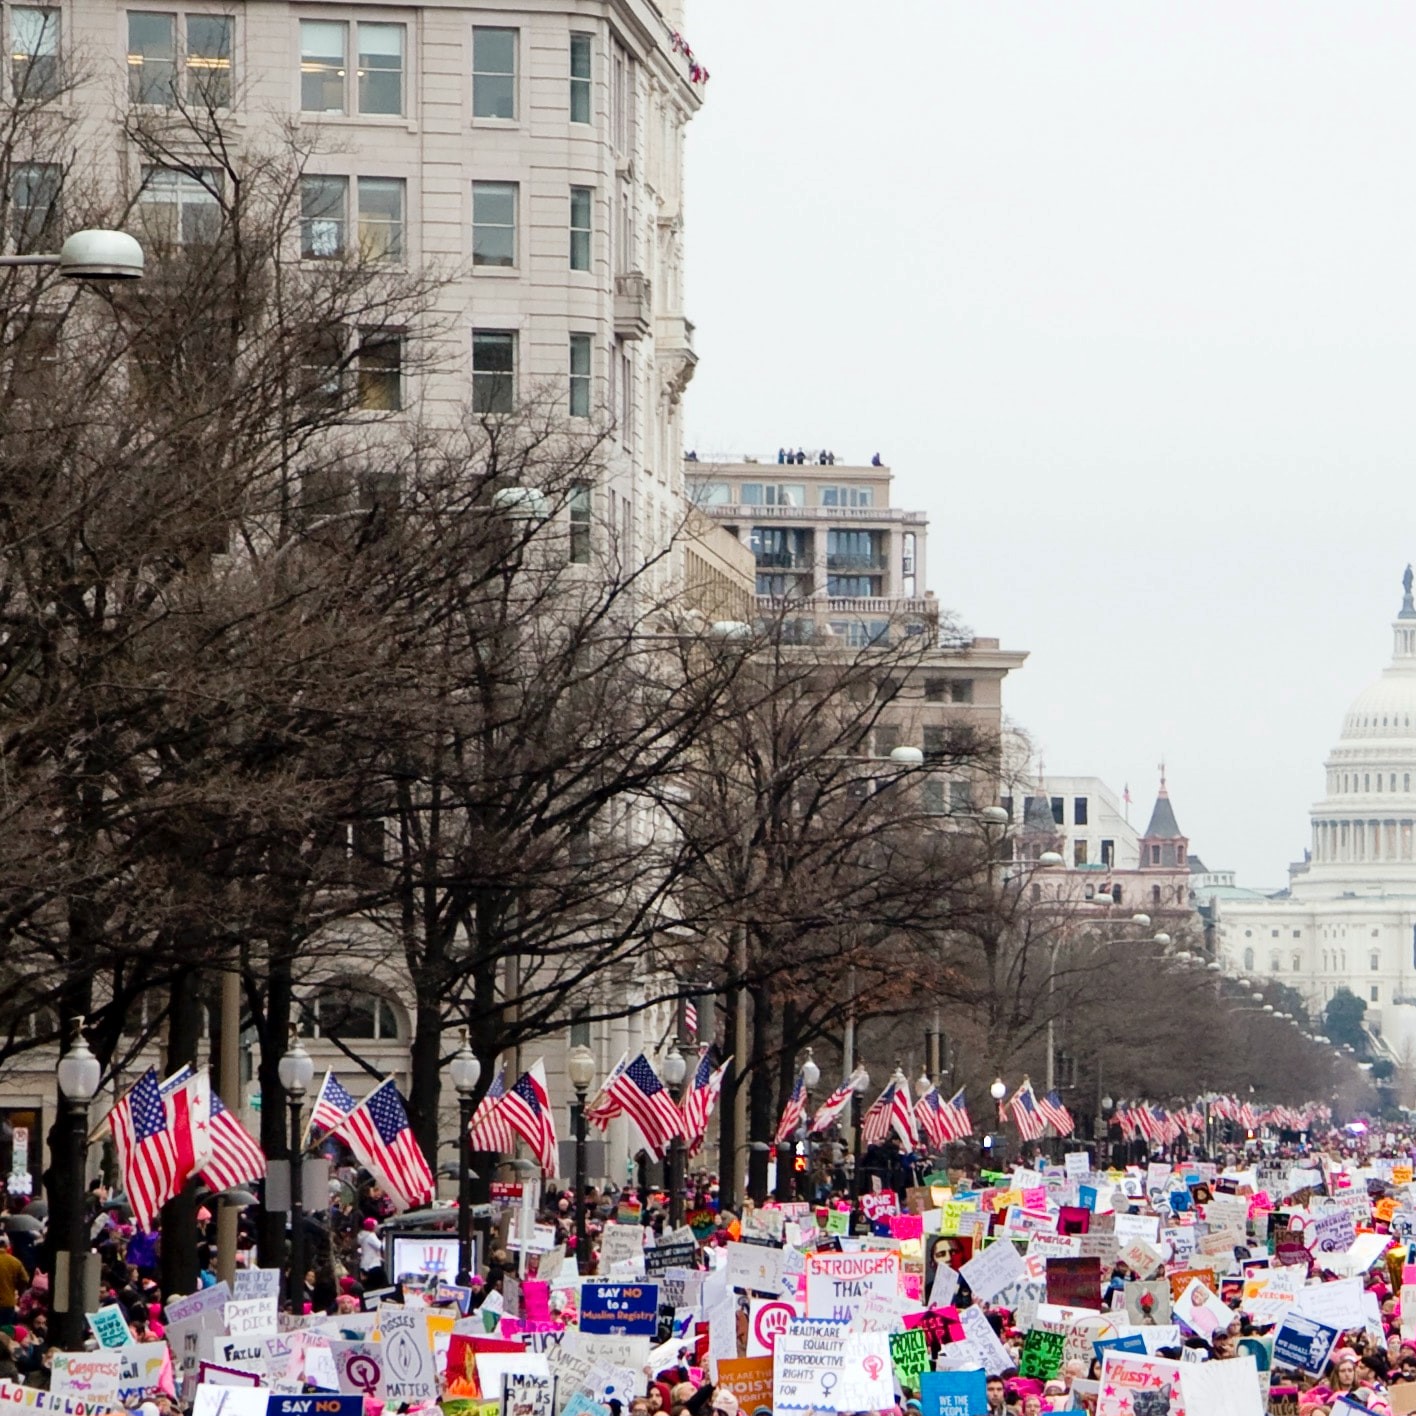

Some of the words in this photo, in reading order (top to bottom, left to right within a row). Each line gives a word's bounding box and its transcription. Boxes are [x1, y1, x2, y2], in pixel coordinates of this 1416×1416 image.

[811, 1258, 894, 1279] STRONGER
[598, 1288, 621, 1299] SAY
[623, 1288, 641, 1299] NO
[789, 1325, 839, 1338] HEALTHCARE
[803, 1339, 844, 1351] EQUALITY
[784, 1354, 844, 1368] REPRODUCTIVE
[783, 1368, 814, 1379] RIGHTS
[387, 1383, 431, 1397] MATTER
[779, 1385, 797, 1395] FOR
[939, 1395, 952, 1406] WE
[953, 1395, 969, 1406] THE
[281, 1401, 311, 1414] SAY
[315, 1401, 341, 1414] NO
[939, 1406, 969, 1416] PEOPLE
